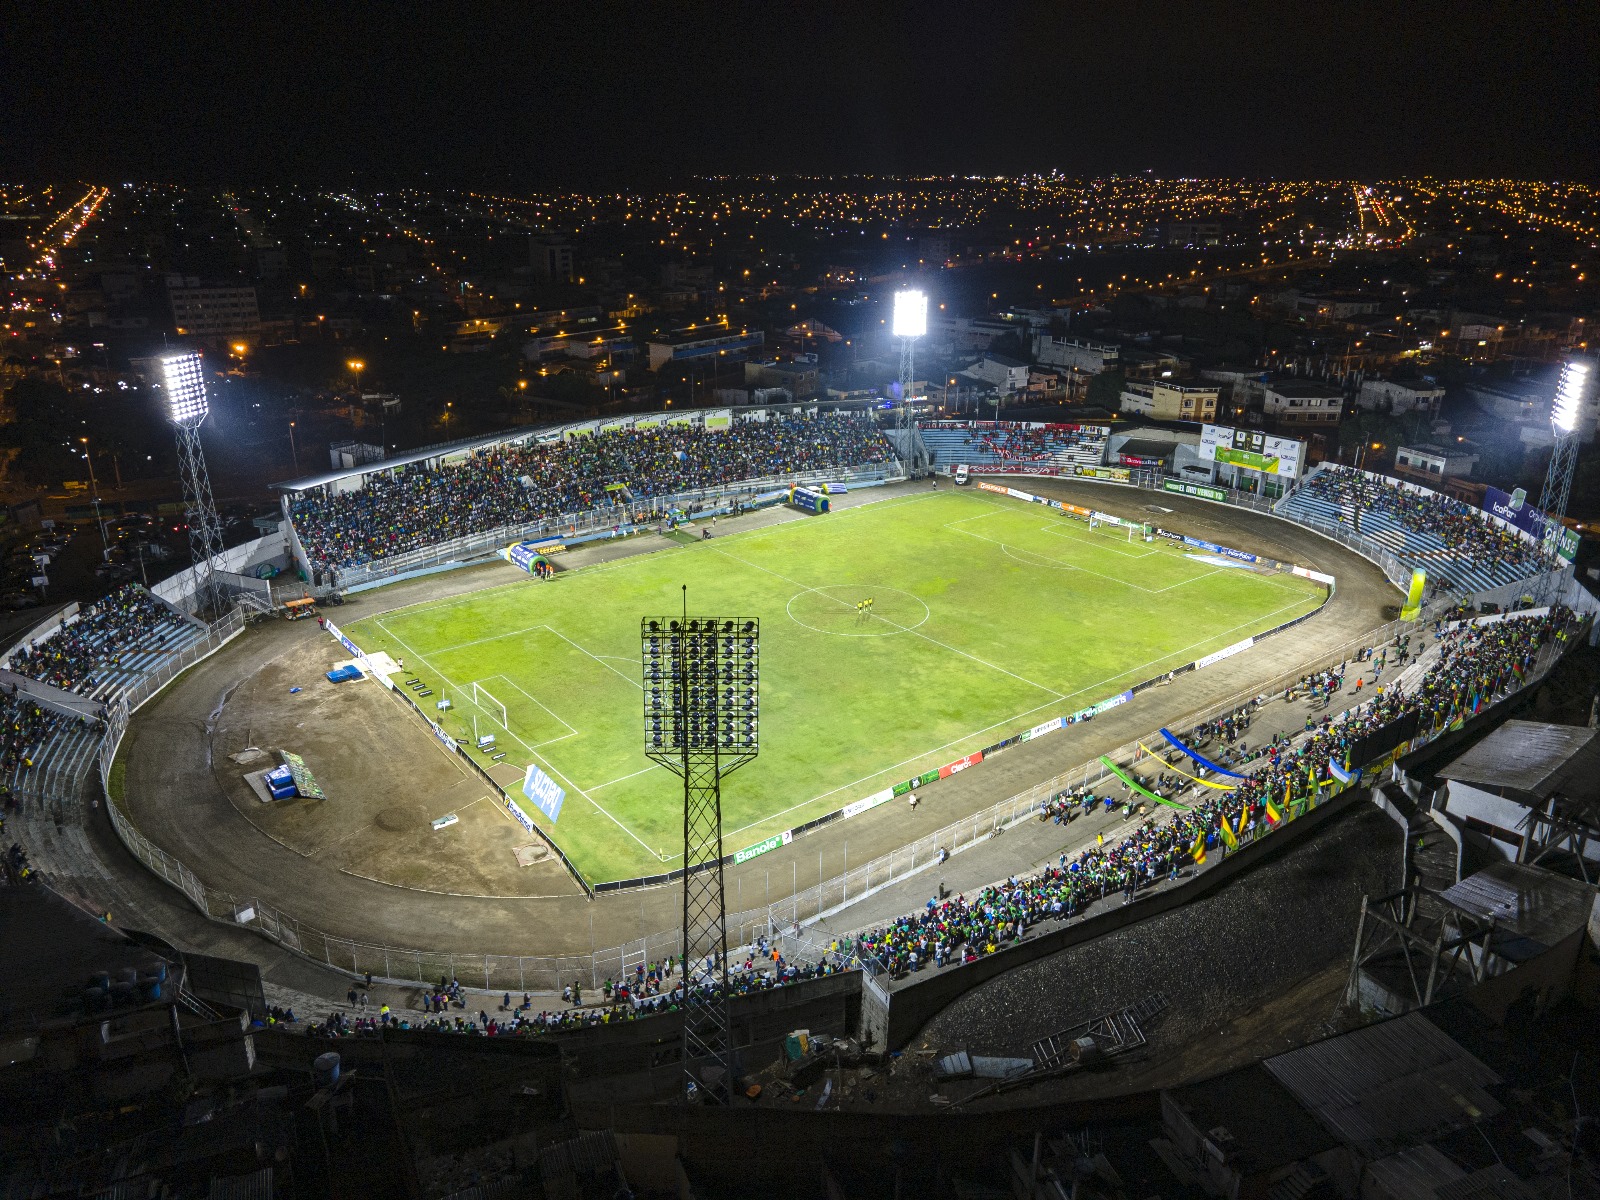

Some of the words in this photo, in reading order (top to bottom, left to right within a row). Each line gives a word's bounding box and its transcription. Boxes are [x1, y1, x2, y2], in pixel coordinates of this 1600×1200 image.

[1492, 502, 1515, 519] IcaPar
[1545, 527, 1576, 554] ORNSE
[951, 761, 971, 774] Claro
[735, 840, 777, 864] Banole
